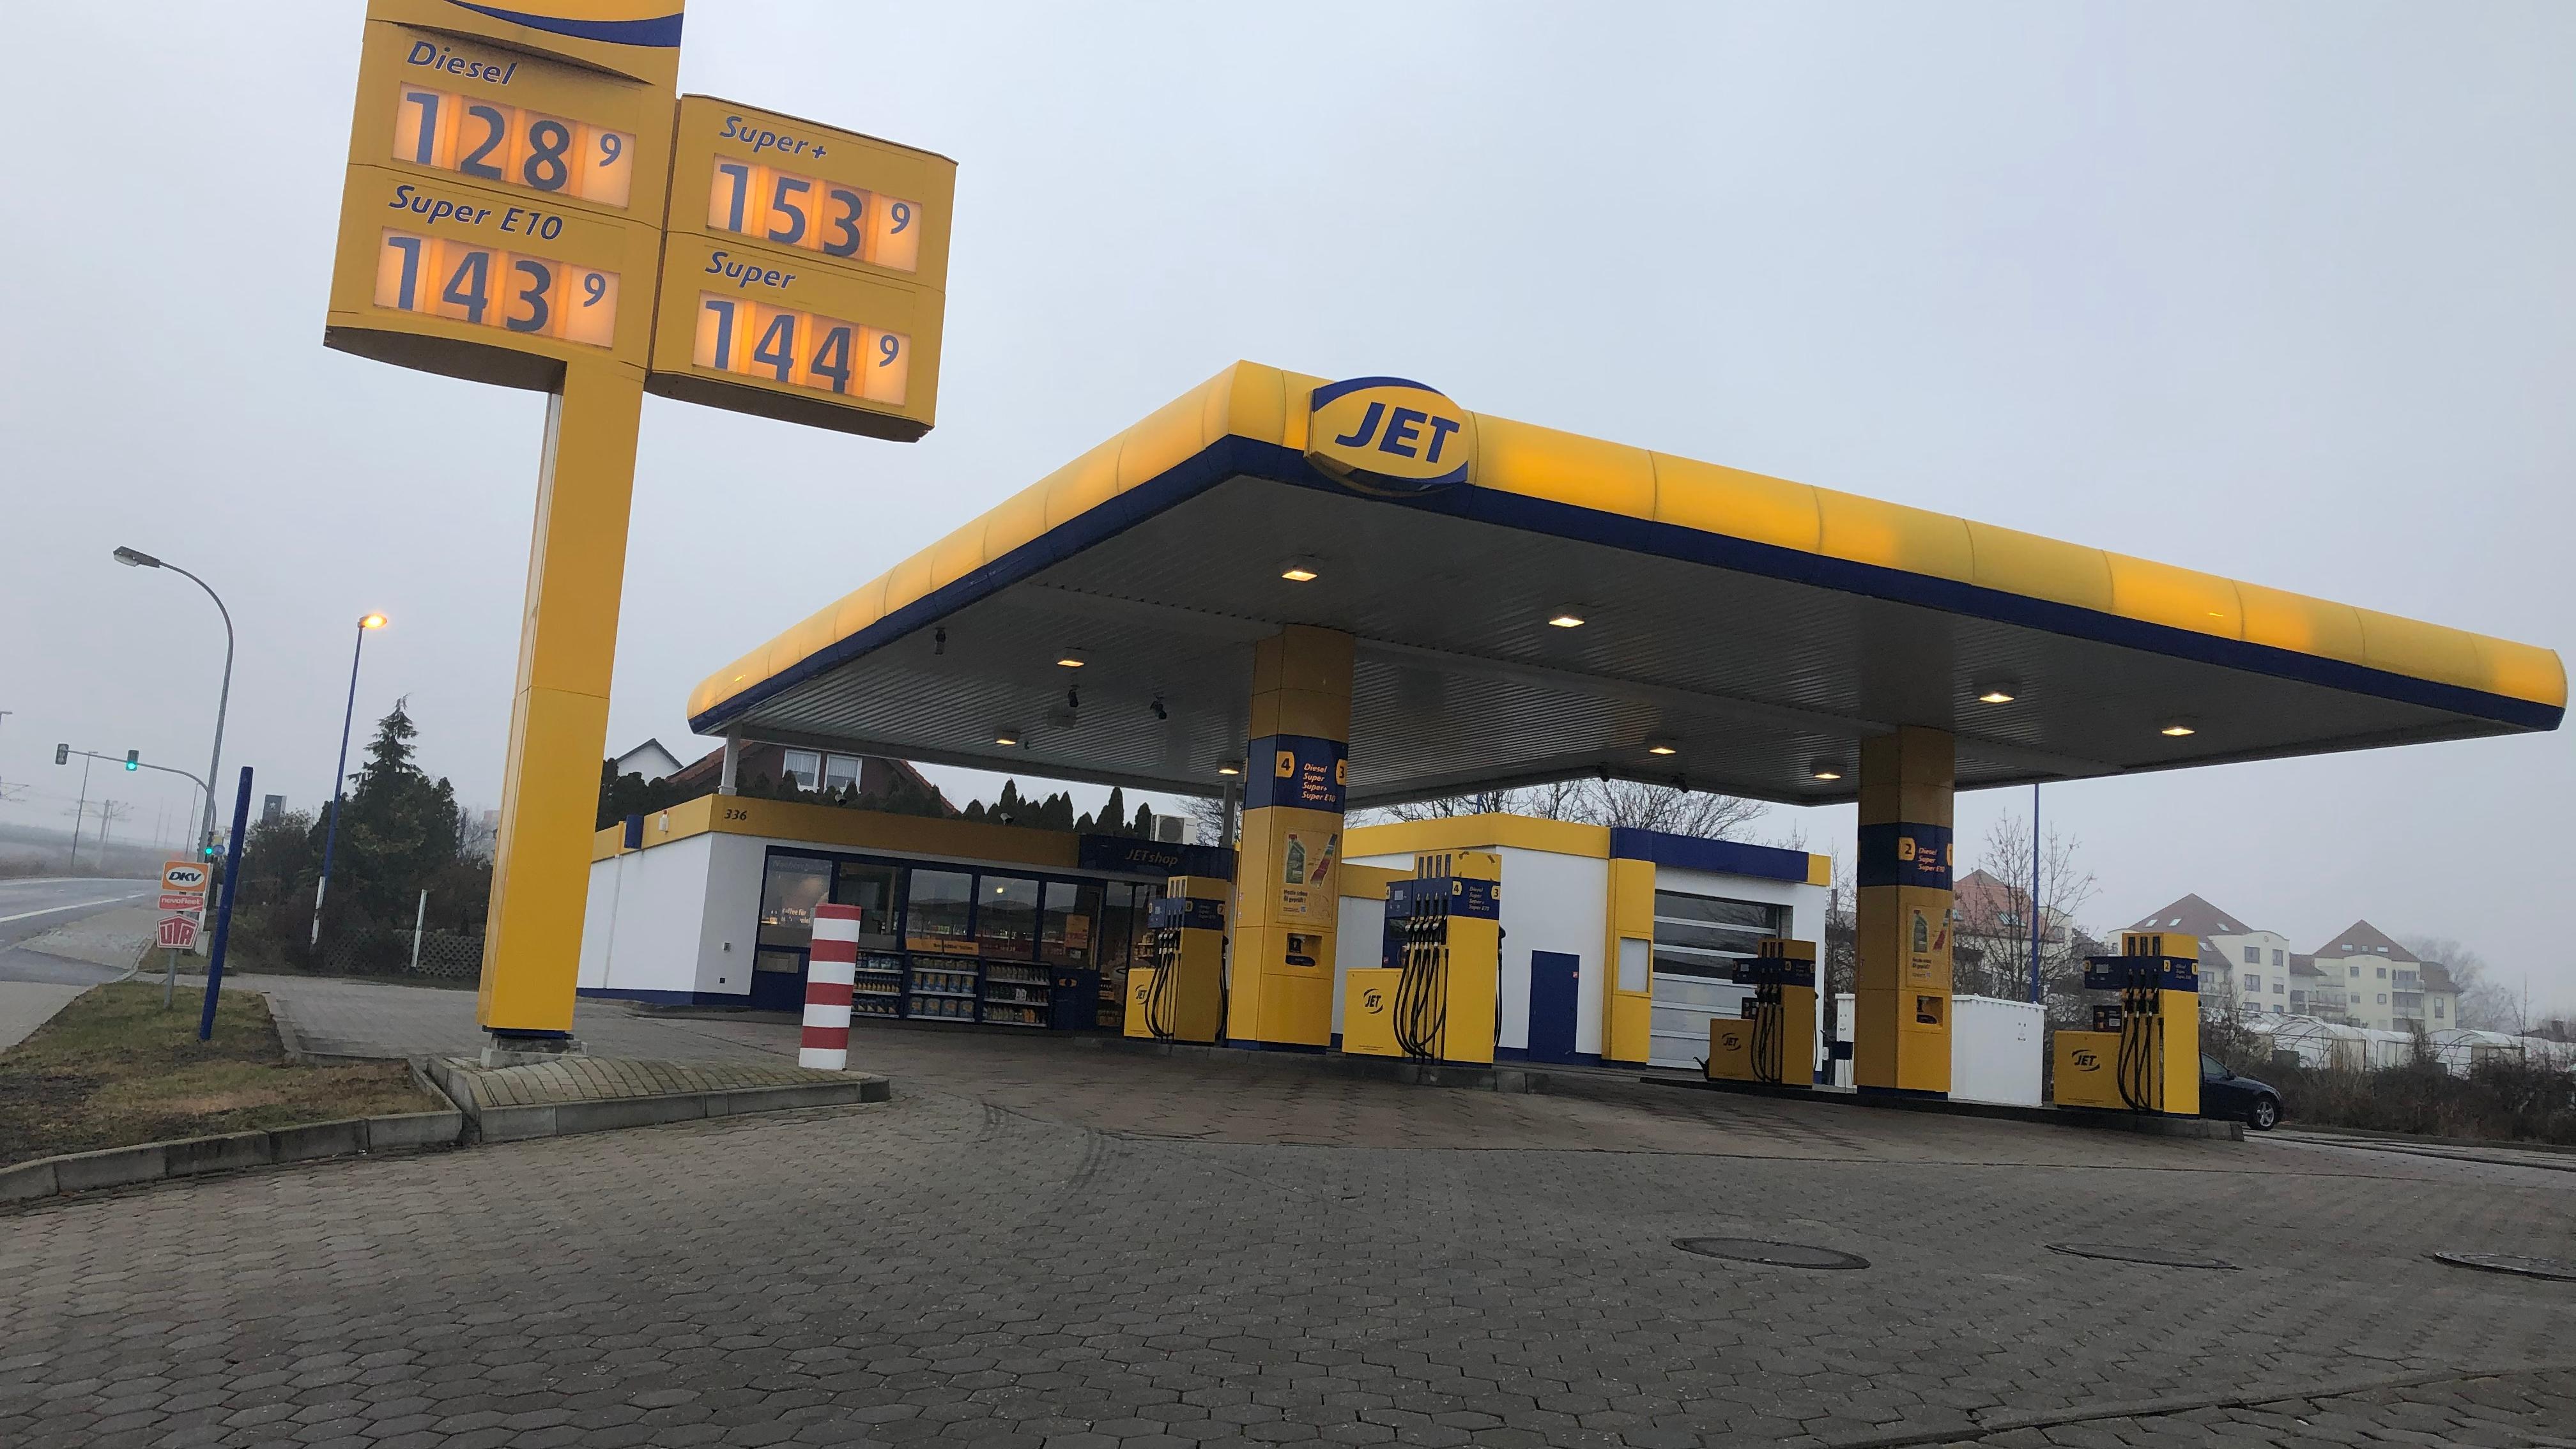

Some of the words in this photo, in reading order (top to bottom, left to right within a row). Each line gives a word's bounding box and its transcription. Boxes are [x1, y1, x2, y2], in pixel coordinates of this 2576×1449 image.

[407, 41, 518, 86] Diesel
[719, 116, 827, 159] Super+
[388, 185, 492, 225] Super
[500, 208, 564, 241] E10
[705, 251, 797, 289] Super
[1335, 401, 1460, 464] JET
[1280, 758, 1291, 771] 4
[1303, 763, 1328, 773] Diesel
[1303, 772, 1325, 782] Super
[1338, 766, 1346, 778] 3
[1301, 781, 1328, 792] Super+
[1301, 790, 1324, 801] Super
[1324, 793, 1337, 802] E10
[724, 808, 747, 821] 336
[1905, 843, 1912, 855] 2
[169, 871, 202, 882] DKV
[160, 917, 197, 946] UTA
[1365, 995, 1382, 1008] JET
[1723, 1037, 1739, 1046] JET
[2074, 1055, 2097, 1066] JET
